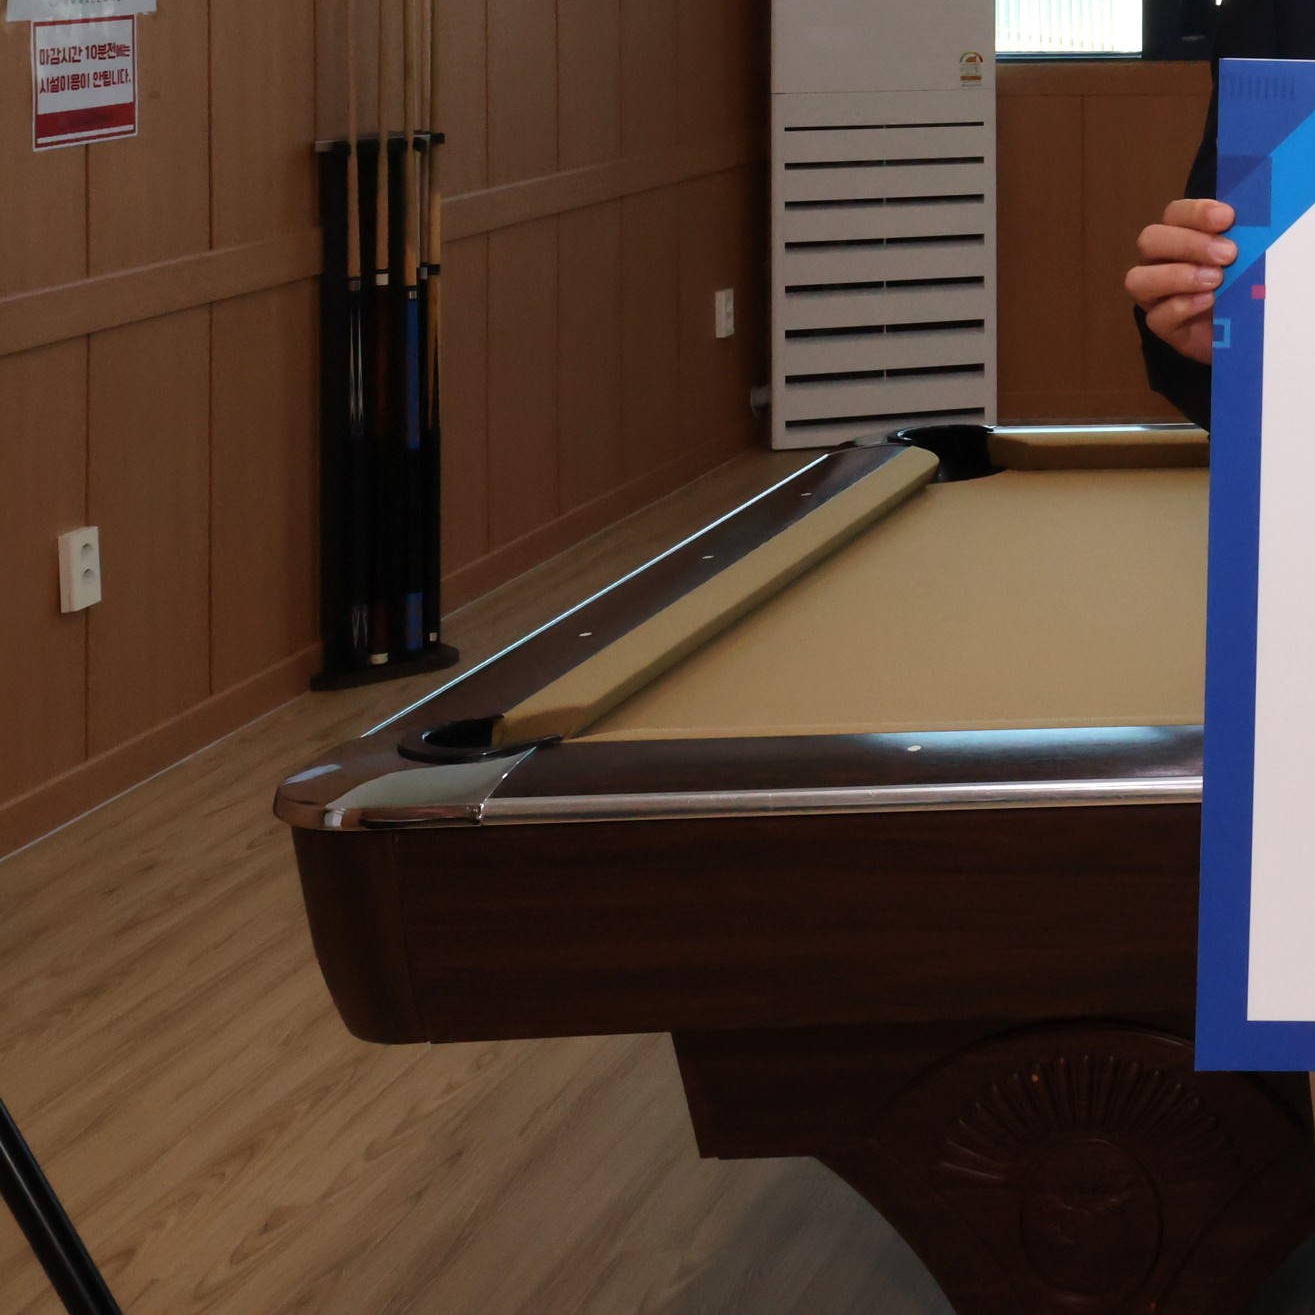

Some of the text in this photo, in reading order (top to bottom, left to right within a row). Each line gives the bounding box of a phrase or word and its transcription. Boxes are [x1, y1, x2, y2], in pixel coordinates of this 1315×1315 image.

[39, 45, 83, 66] 마감시간
[39, 68, 132, 94] 시설이용이 안됩니다.
